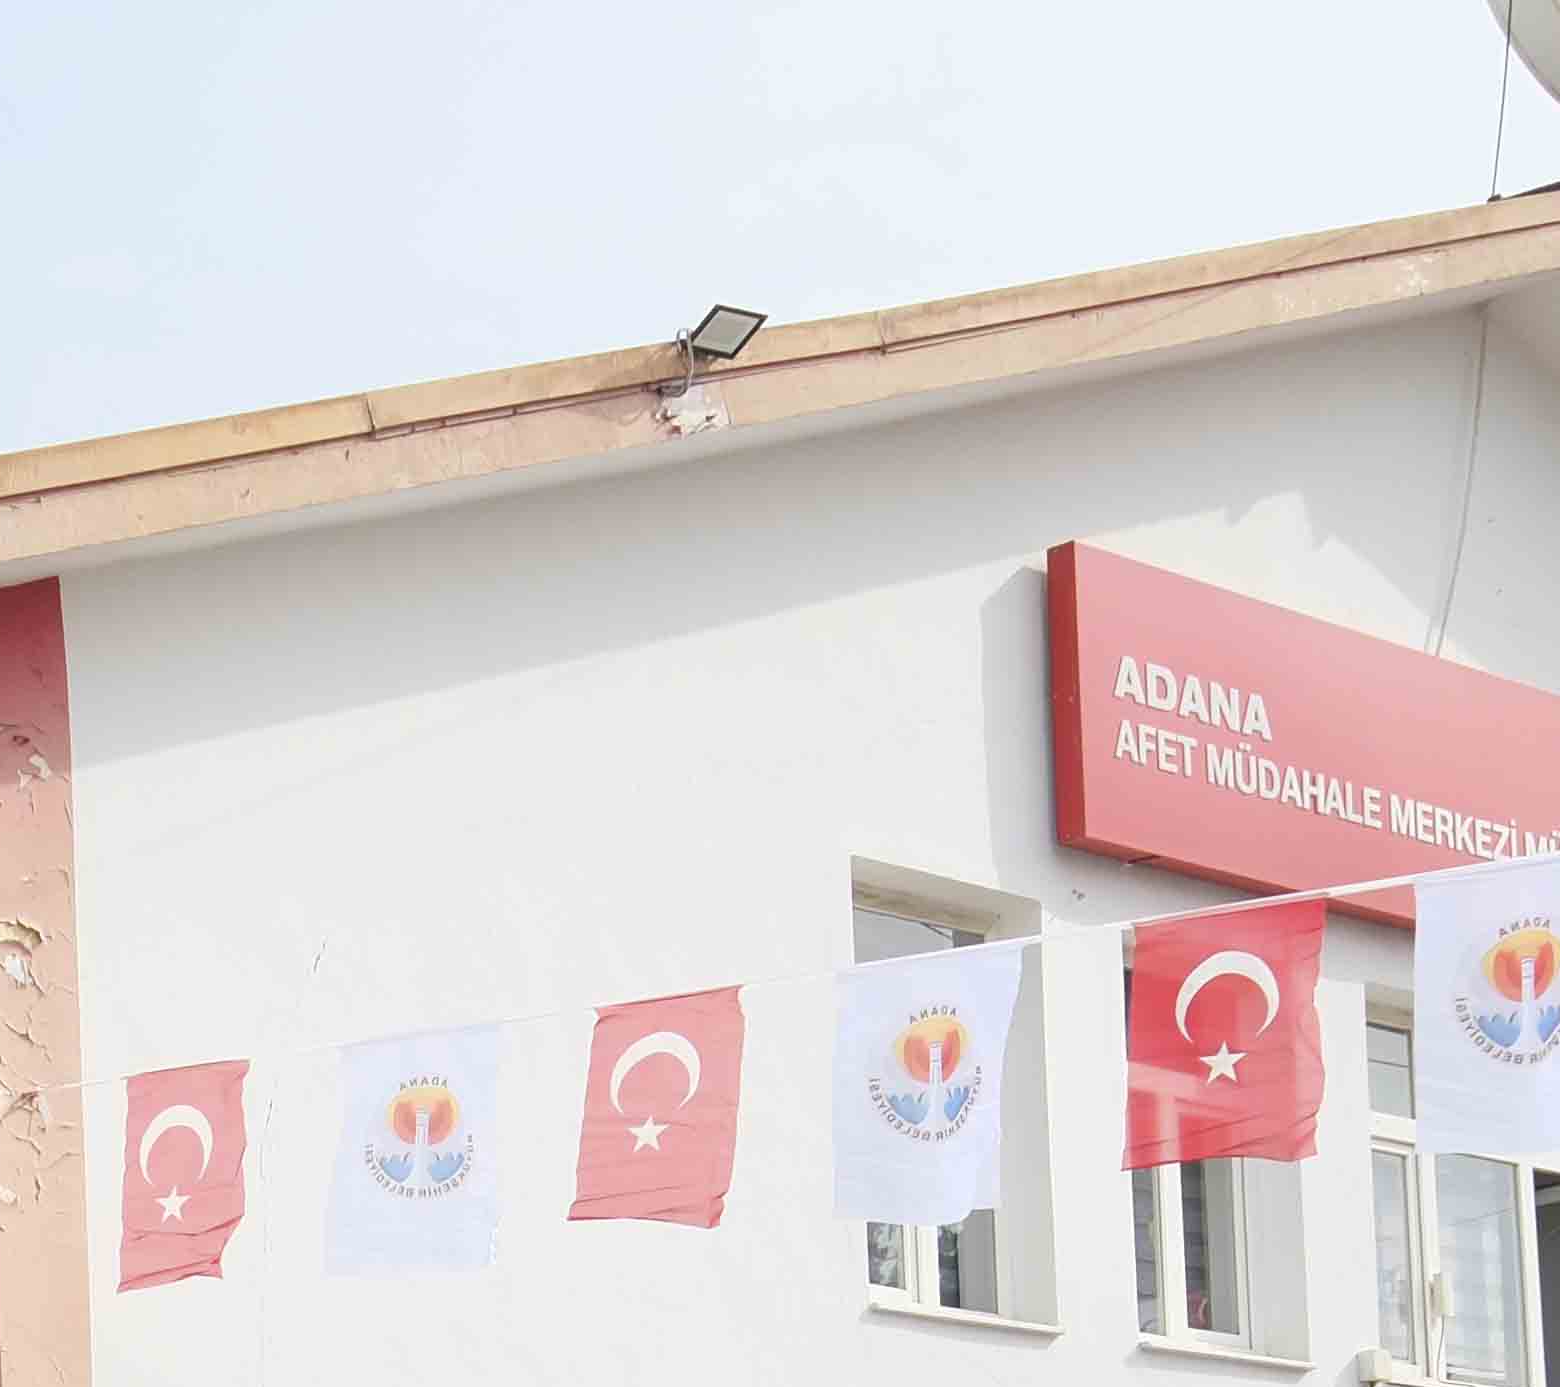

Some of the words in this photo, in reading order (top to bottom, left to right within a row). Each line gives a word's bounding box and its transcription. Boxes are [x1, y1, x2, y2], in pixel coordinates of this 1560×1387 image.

[1112, 655, 1273, 741] ADANA
[1113, 719, 1198, 778] AFET
[1205, 742, 1384, 829] MÜDAHALE
[1389, 793, 1521, 860] MERKEZİ
